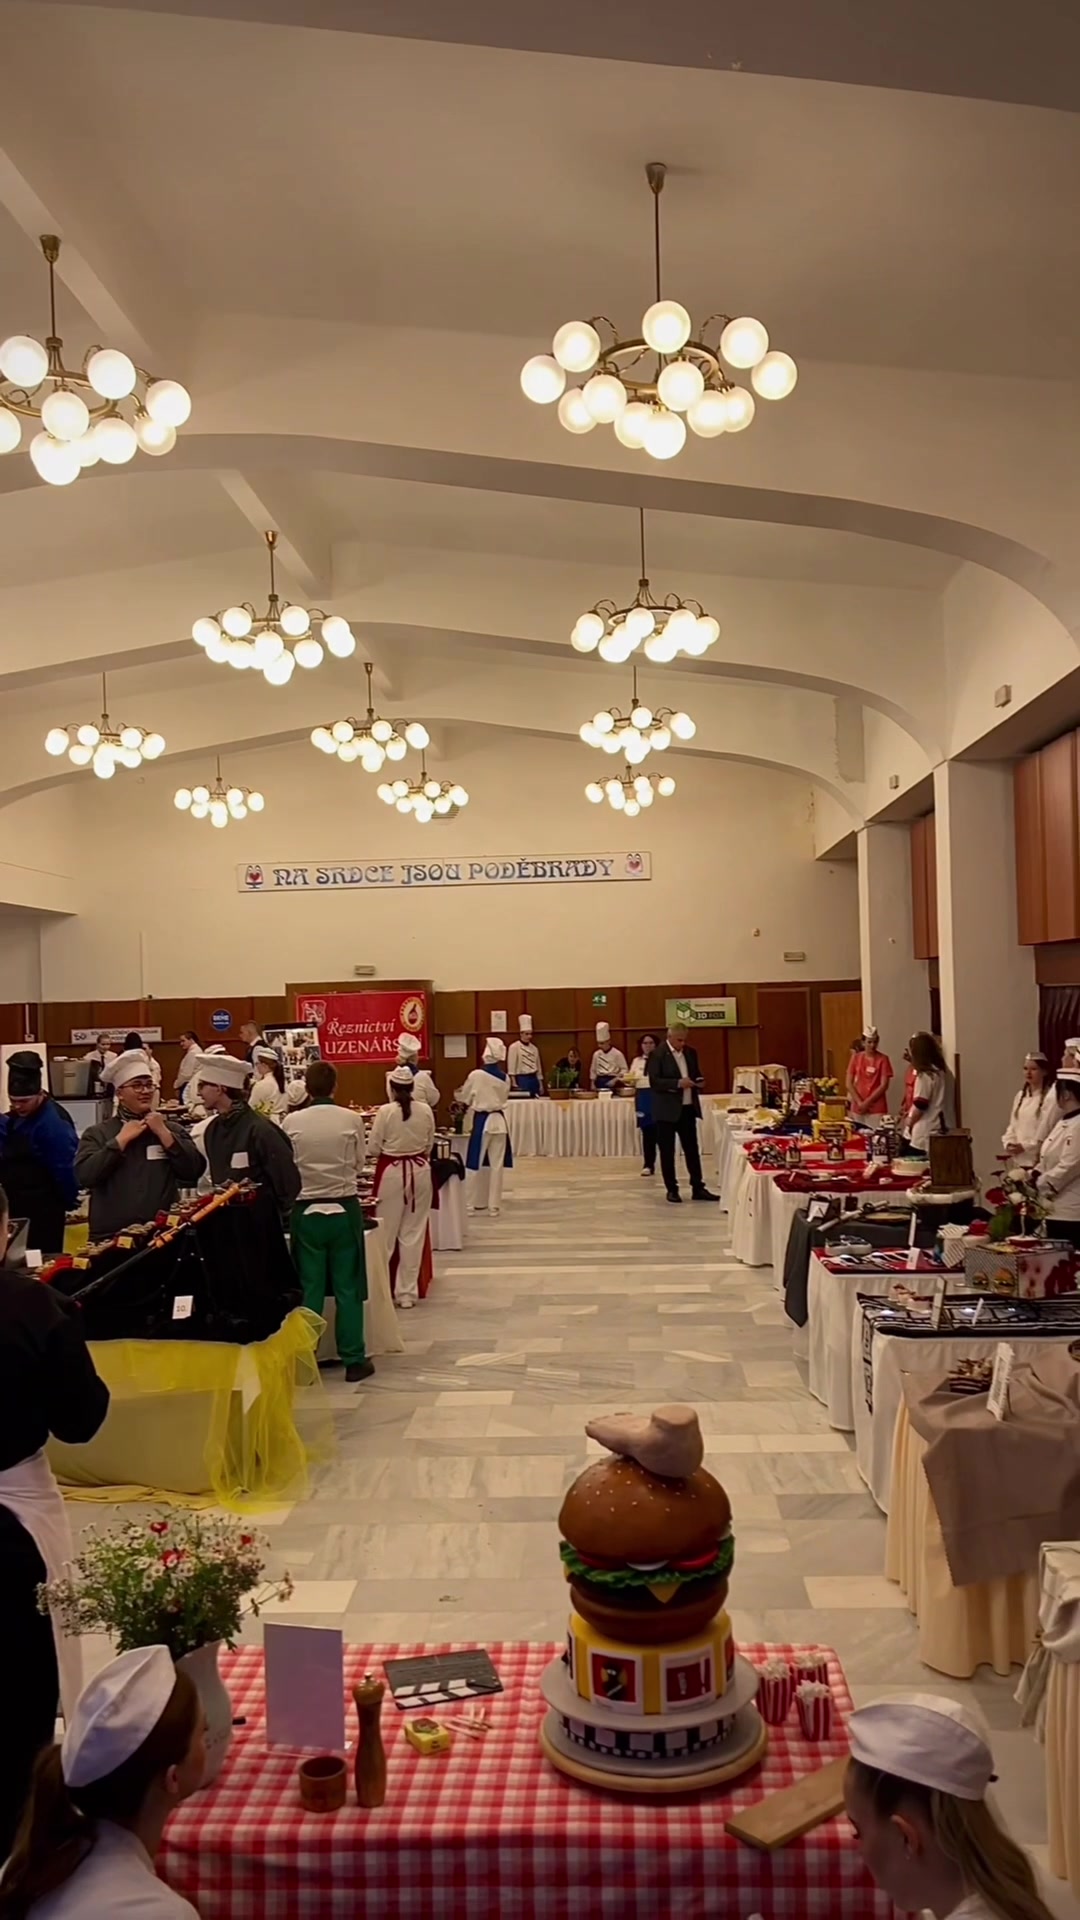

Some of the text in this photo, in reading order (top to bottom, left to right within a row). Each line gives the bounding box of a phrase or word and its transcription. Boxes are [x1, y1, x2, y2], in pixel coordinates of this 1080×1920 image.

[272, 858, 614, 886] NA SRDCE JSOU PODĚBRADY
[326, 1018, 396, 1037] Řeznictví
[325, 1034, 422, 1055] UZENÁŘS
